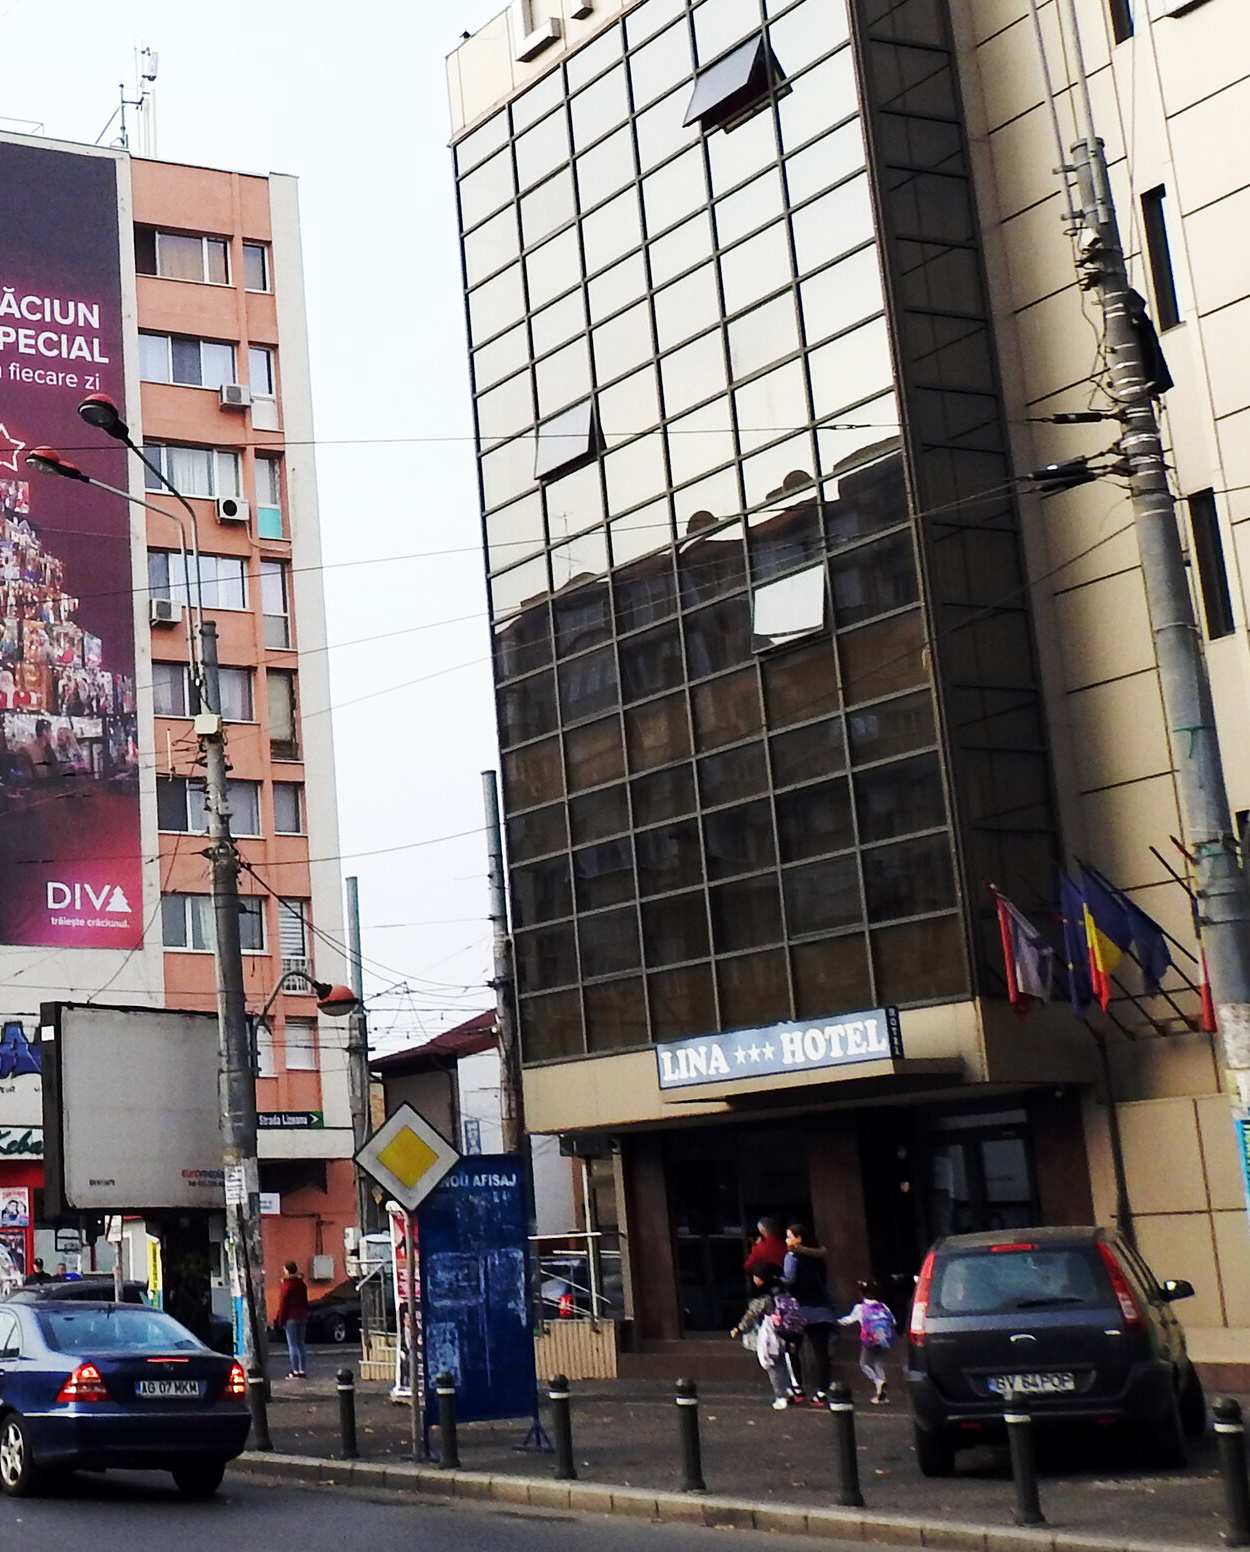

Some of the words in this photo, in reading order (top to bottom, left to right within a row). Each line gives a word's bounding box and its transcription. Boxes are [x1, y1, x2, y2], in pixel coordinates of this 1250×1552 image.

[8, 362, 78, 388] fiecare
[84, 373, 100, 391] zi
[661, 1044, 731, 1081] LINA
[780, 1019, 889, 1065] HOTEL
[473, 1173, 517, 1188] AFISAJ
